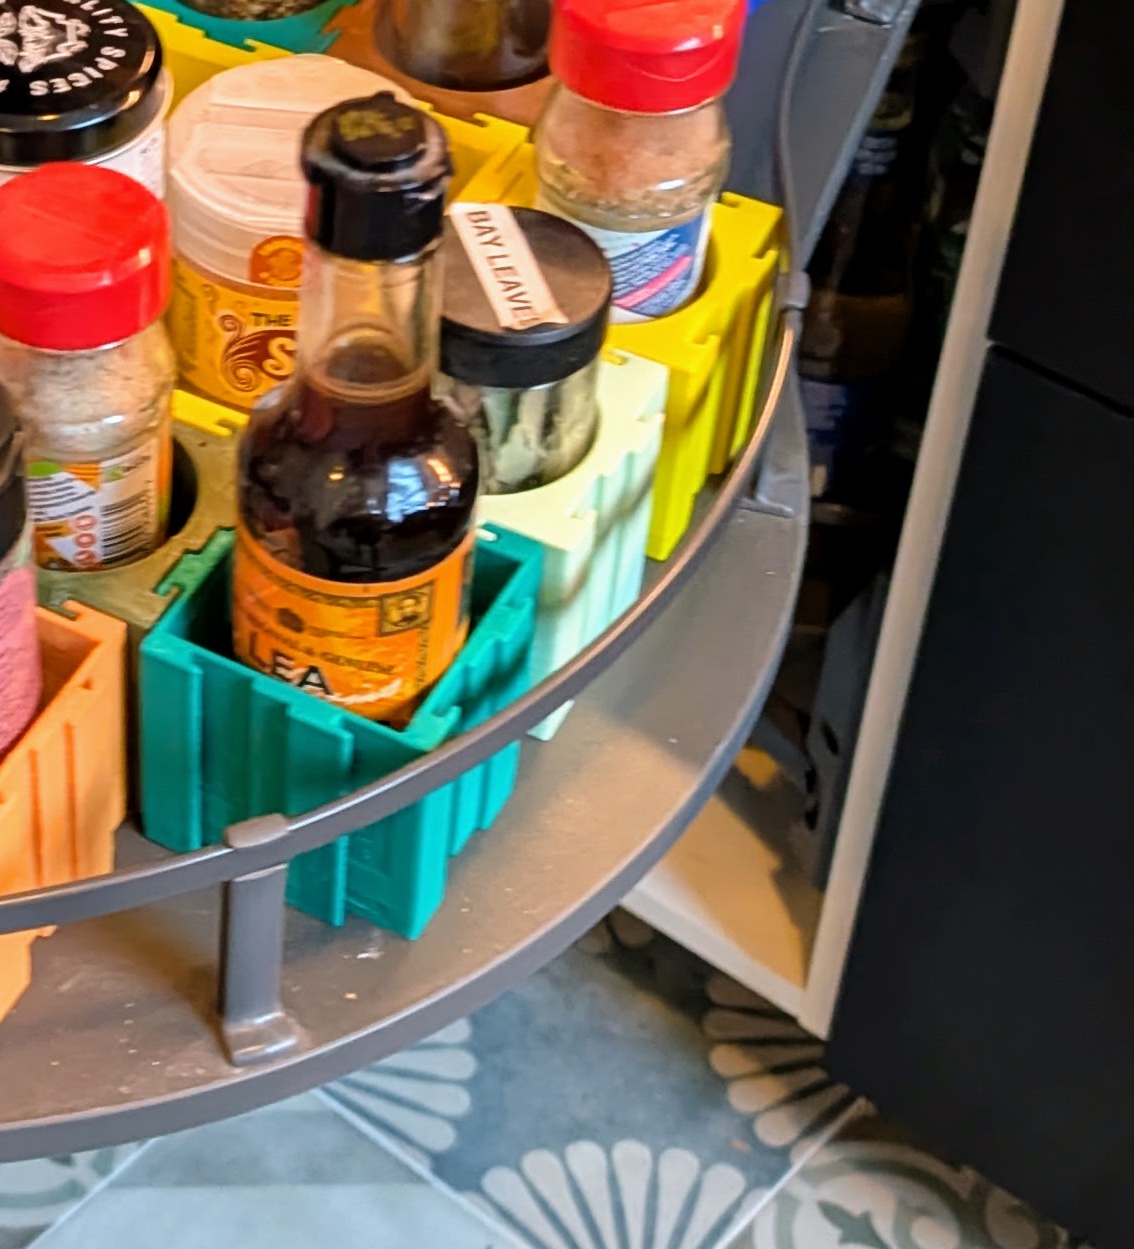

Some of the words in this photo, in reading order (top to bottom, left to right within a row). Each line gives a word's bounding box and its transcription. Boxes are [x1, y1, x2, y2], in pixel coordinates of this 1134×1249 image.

[29, 47, 127, 96] SPICES
[466, 210, 505, 247] BAY
[250, 312, 292, 327] THE
[249, 630, 334, 696] LEA
